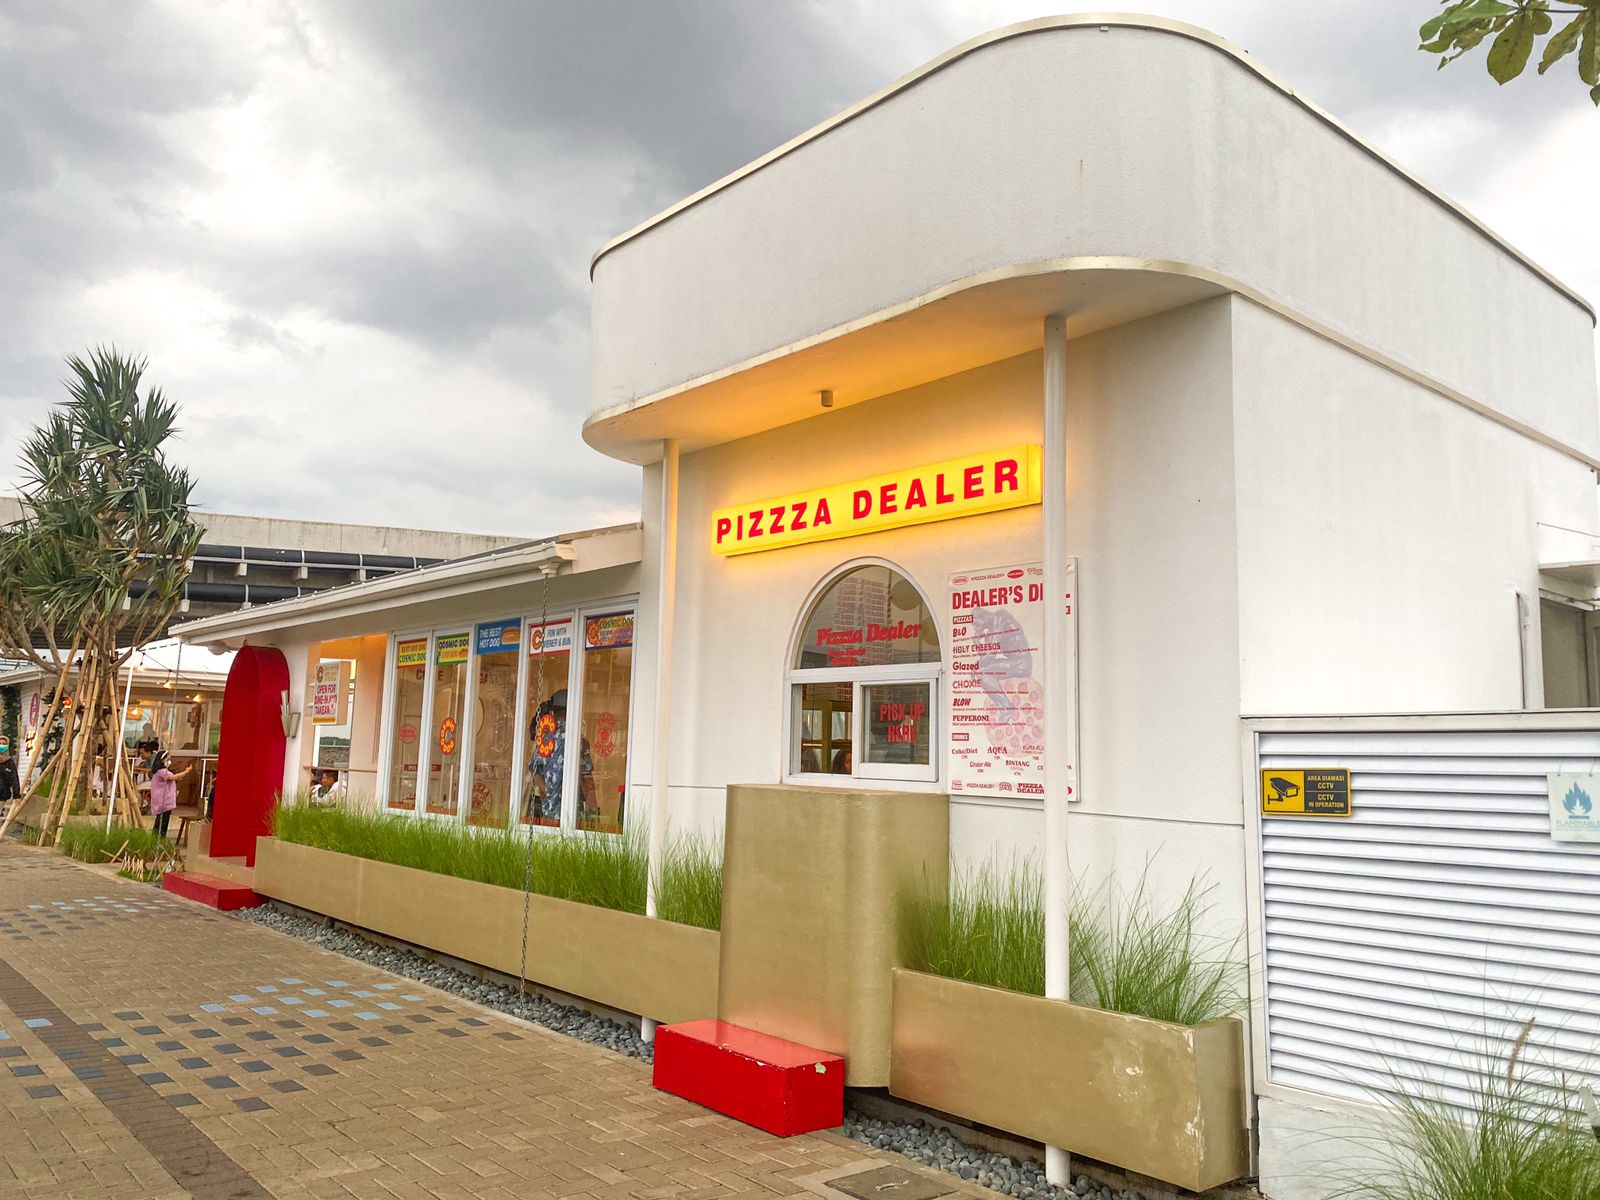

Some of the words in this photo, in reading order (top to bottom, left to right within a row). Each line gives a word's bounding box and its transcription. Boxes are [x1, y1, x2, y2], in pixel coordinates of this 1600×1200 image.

[717, 498, 832, 544] PIZZZA
[853, 459, 1018, 520] DEALER
[953, 585, 1023, 610] DEALER'S
[480, 629, 490, 638] THE
[490, 627, 502, 638] BEST
[547, 629, 556, 637] FUN
[556, 626, 568, 636] WITH
[866, 620, 922, 643] Dealer
[439, 640, 458, 649] COSMIC
[479, 638, 490, 648] HOT
[490, 638, 500, 647] DOG
[562, 638, 571, 646] BUN
[400, 654, 416, 663] COSMIC
[952, 662, 980, 670] Glazed
[316, 685, 327, 694] OPEN
[328, 684, 336, 693] FOR
[952, 679, 982, 689] CHOXIE
[952, 698, 972, 706] BLOW
